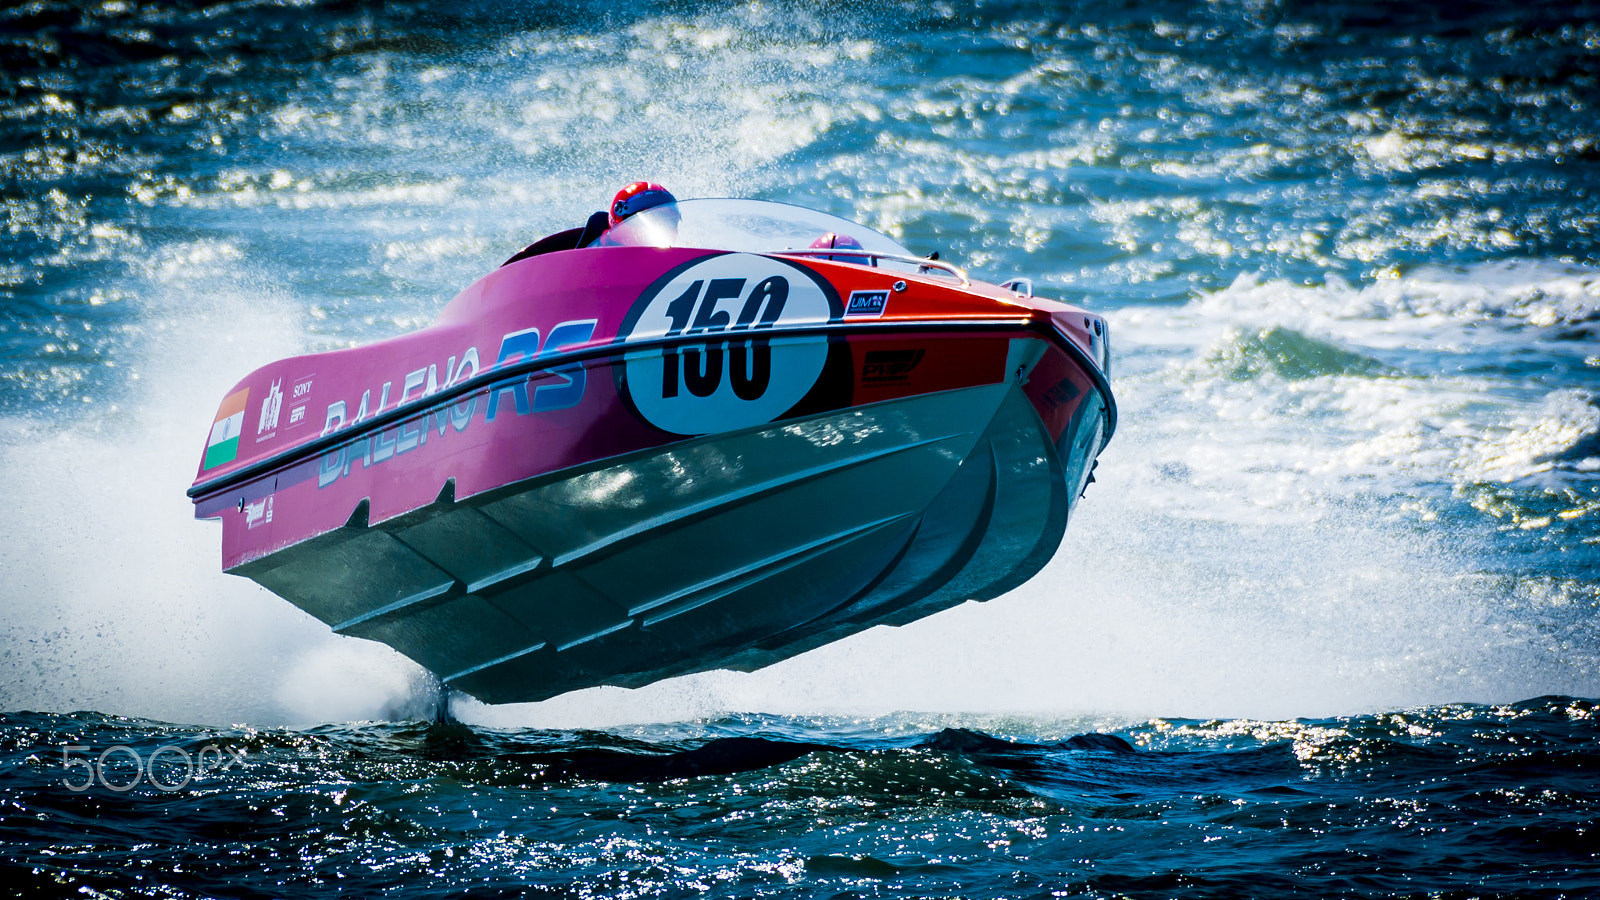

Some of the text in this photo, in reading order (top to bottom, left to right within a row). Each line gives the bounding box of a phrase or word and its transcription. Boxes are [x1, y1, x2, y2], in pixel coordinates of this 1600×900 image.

[662, 275, 789, 401] 150
[851, 297, 872, 308] UIM
[293, 380, 313, 398] SONY
[318, 318, 598, 490] BALENO RS
